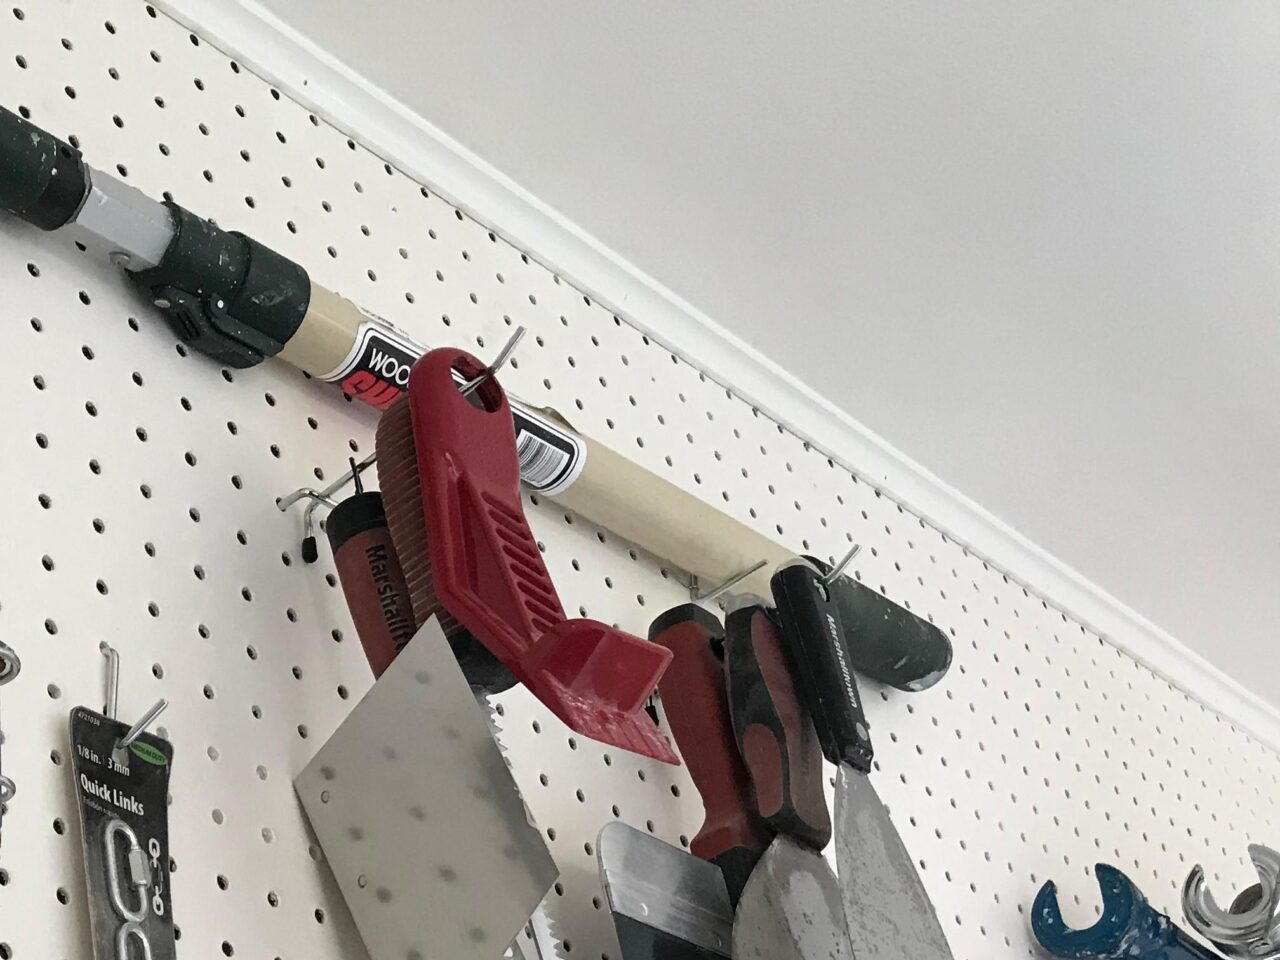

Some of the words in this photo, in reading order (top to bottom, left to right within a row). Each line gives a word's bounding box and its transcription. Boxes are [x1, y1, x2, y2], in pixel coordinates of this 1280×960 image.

[368, 347, 411, 388] WOO
[77, 744, 90, 762] 1/8
[107, 757, 113, 769] 3
[114, 761, 131, 777] mm
[80, 773, 112, 803] Quick
[113, 788, 145, 816] Links
